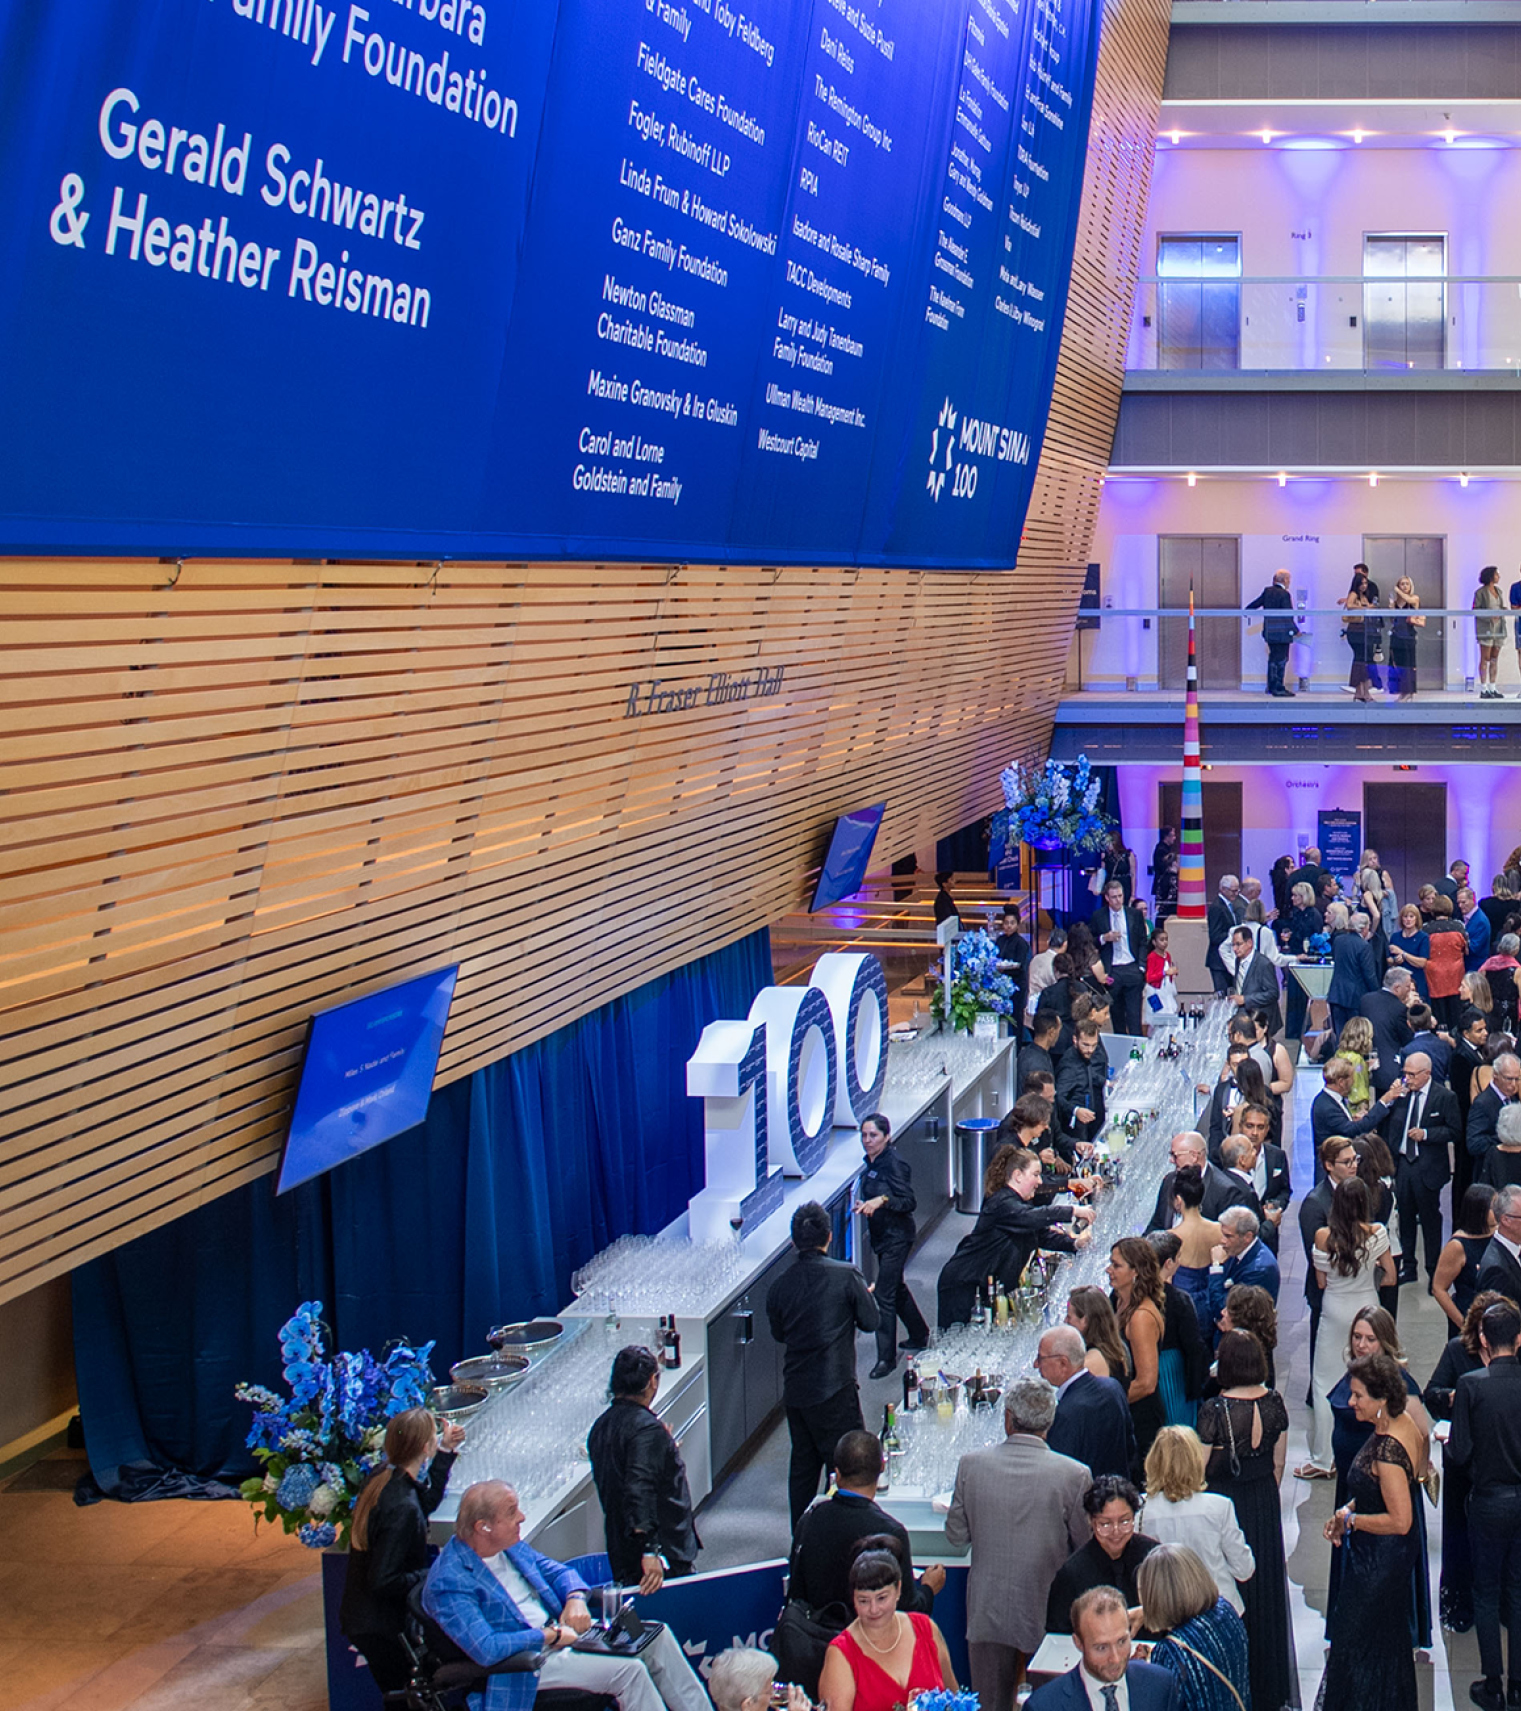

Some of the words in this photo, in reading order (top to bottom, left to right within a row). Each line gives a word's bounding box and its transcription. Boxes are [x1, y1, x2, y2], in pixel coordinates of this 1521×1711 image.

[657, 0, 692, 42] Family
[714, 0, 737, 38] Toby
[737, 13, 775, 67] Feldberg
[343, 4, 518, 138] Foundation
[637, 42, 687, 95] Fieldgate
[688, 77, 716, 114] Cares
[716, 95, 765, 146] Foundation
[628, 100, 665, 147] Fogler,
[667, 123, 712, 164] Rubinoff
[710, 148, 731, 177] LLP
[815, 74, 828, 102] The
[862, 114, 882, 148] Group
[100, 87, 252, 196] Gerald
[261, 143, 425, 250] Schwartz
[620, 158, 651, 196] Linda
[653, 175, 679, 210] Frum
[681, 190, 690, 215] &
[690, 194, 728, 232] Howard
[727, 213, 778, 255] Sokolowski
[50, 172, 90, 249] &
[105, 186, 280, 291] Heather
[288, 238, 431, 328] Reisman
[612, 217, 642, 252] Ganz
[642, 229, 677, 271] Family
[677, 244, 728, 287] Foundation
[602, 274, 647, 312] Newton
[648, 291, 695, 329] Glassman
[806, 271, 852, 309] Developments
[597, 312, 654, 351] Charitable
[655, 330, 708, 367] Foundation
[778, 306, 799, 338] Larry
[798, 318, 813, 339] and
[773, 336, 798, 368] Family
[797, 345, 834, 376] Foundation
[587, 369, 629, 401] Maxine
[630, 379, 682, 419] Granovsky
[682, 392, 691, 415] &
[692, 394, 705, 419] Ira
[706, 398, 738, 426] Gluskin
[578, 427, 613, 456] Carol
[612, 433, 635, 460] and
[635, 436, 665, 464] Lorne
[794, 436, 820, 462] Capital
[959, 416, 1000, 458] MOUNT
[572, 464, 628, 494] Goldstein
[628, 472, 650, 496] and
[650, 474, 682, 506] Family
[952, 463, 978, 499] 100
[1282, 534, 1303, 542] Grand
[1305, 534, 1320, 544] Ring
[624, 682, 642, 719] R.
[647, 679, 703, 714] Fraser
[705, 672, 750, 706] Elliott
[753, 665, 785, 697] Hall
[1285, 780, 1319, 788] Orchestra
[687, 953, 889, 1240] 100
